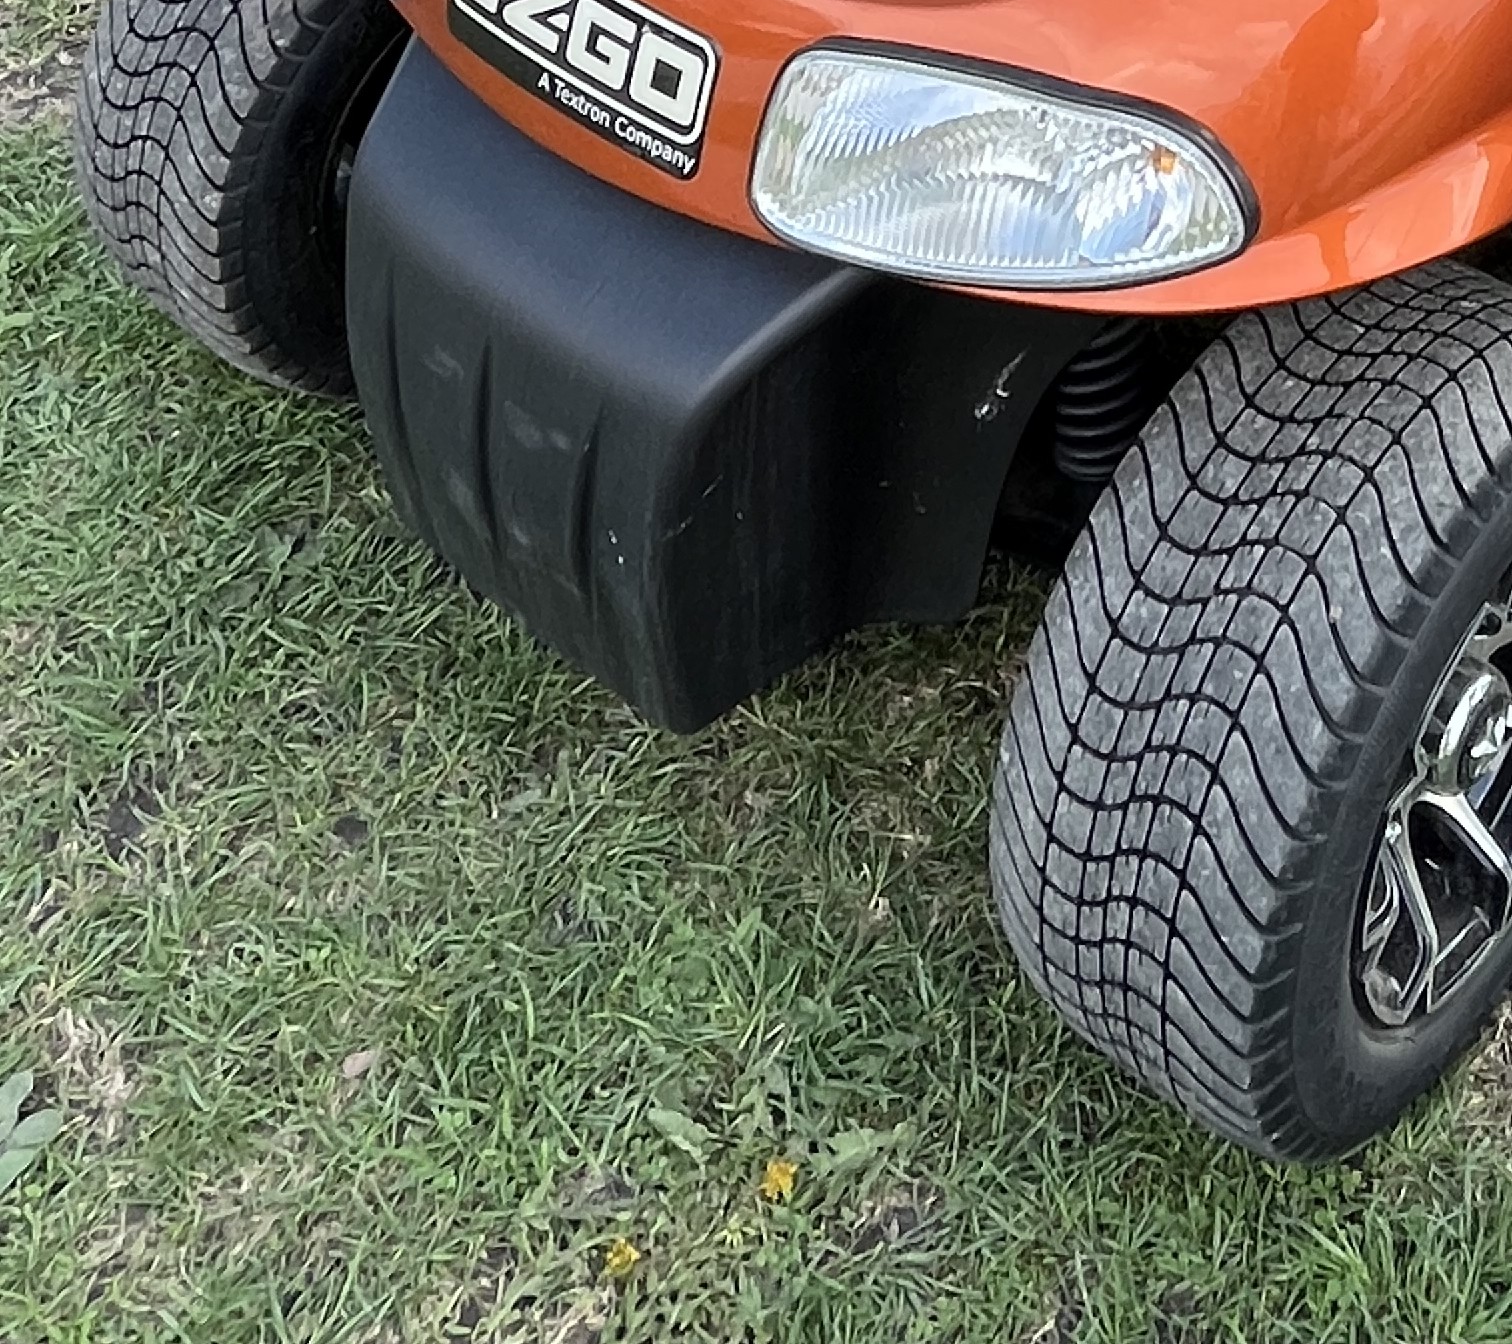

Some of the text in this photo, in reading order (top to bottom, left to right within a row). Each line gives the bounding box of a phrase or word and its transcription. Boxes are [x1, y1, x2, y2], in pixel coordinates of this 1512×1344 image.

[537, 72, 696, 176] A Textron Company
